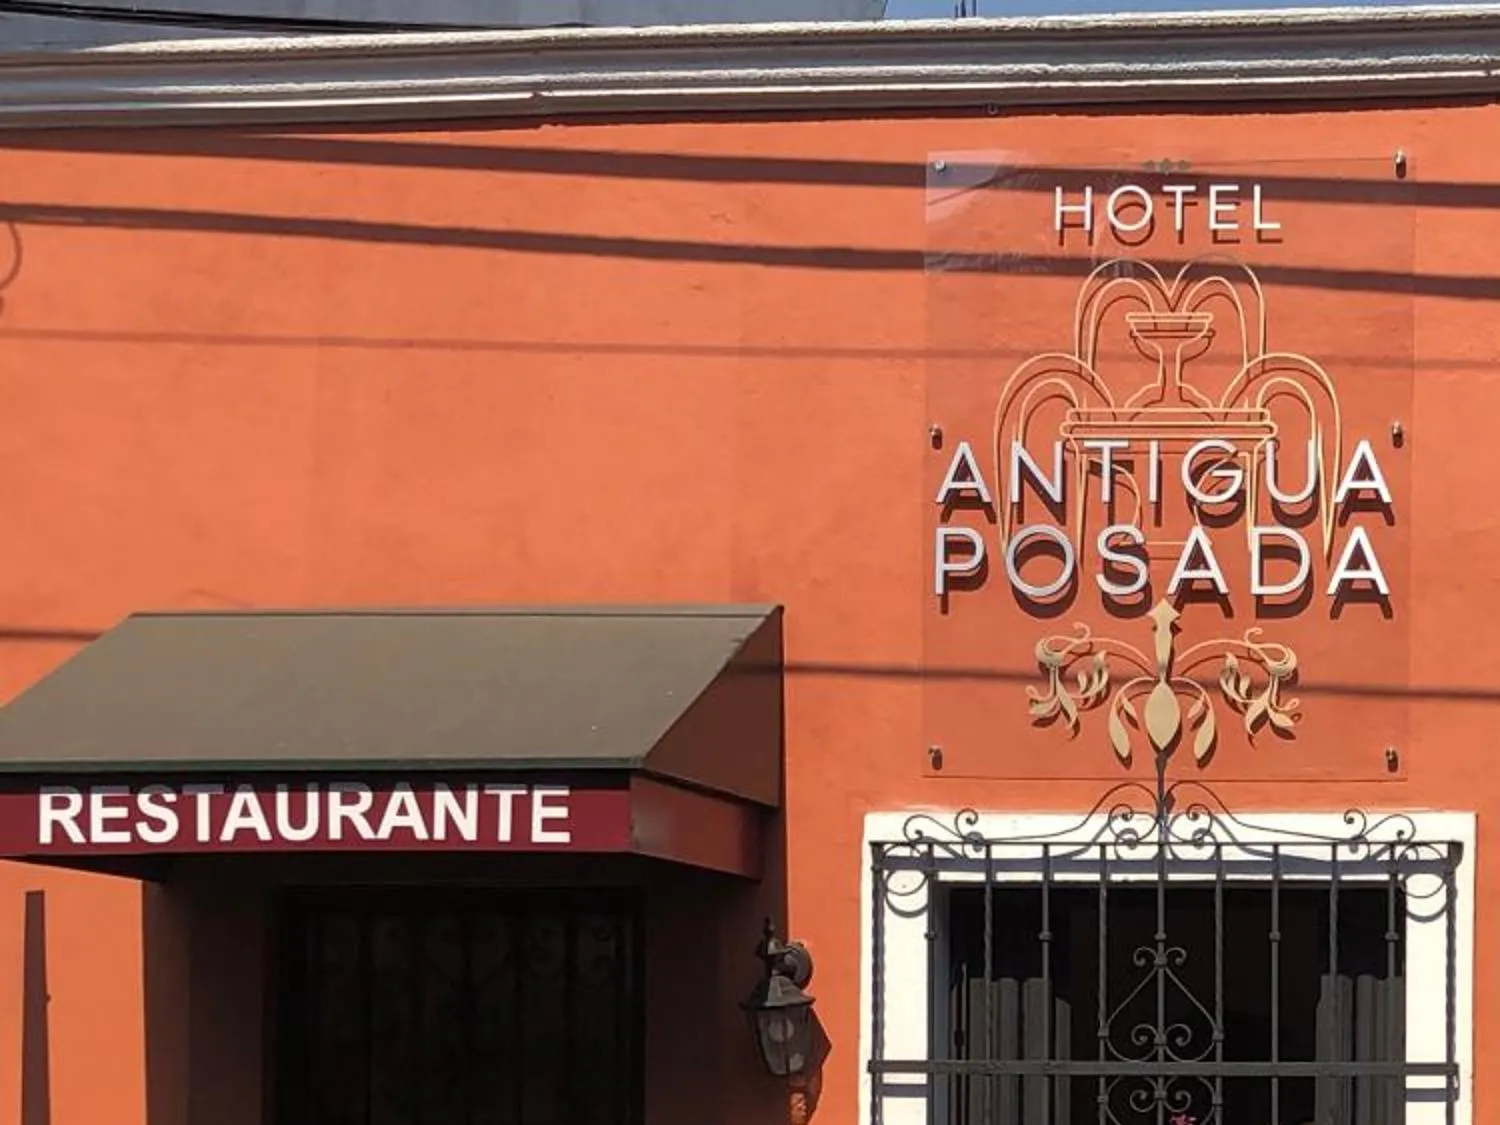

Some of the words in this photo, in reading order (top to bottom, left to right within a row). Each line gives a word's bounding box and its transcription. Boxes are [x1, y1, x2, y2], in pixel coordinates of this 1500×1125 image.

[1054, 184, 1282, 232] HOTEL
[935, 439, 1393, 504] ANTIGUA
[934, 524, 1391, 597] POSADA
[37, 781, 573, 845] RESTAURANTE
